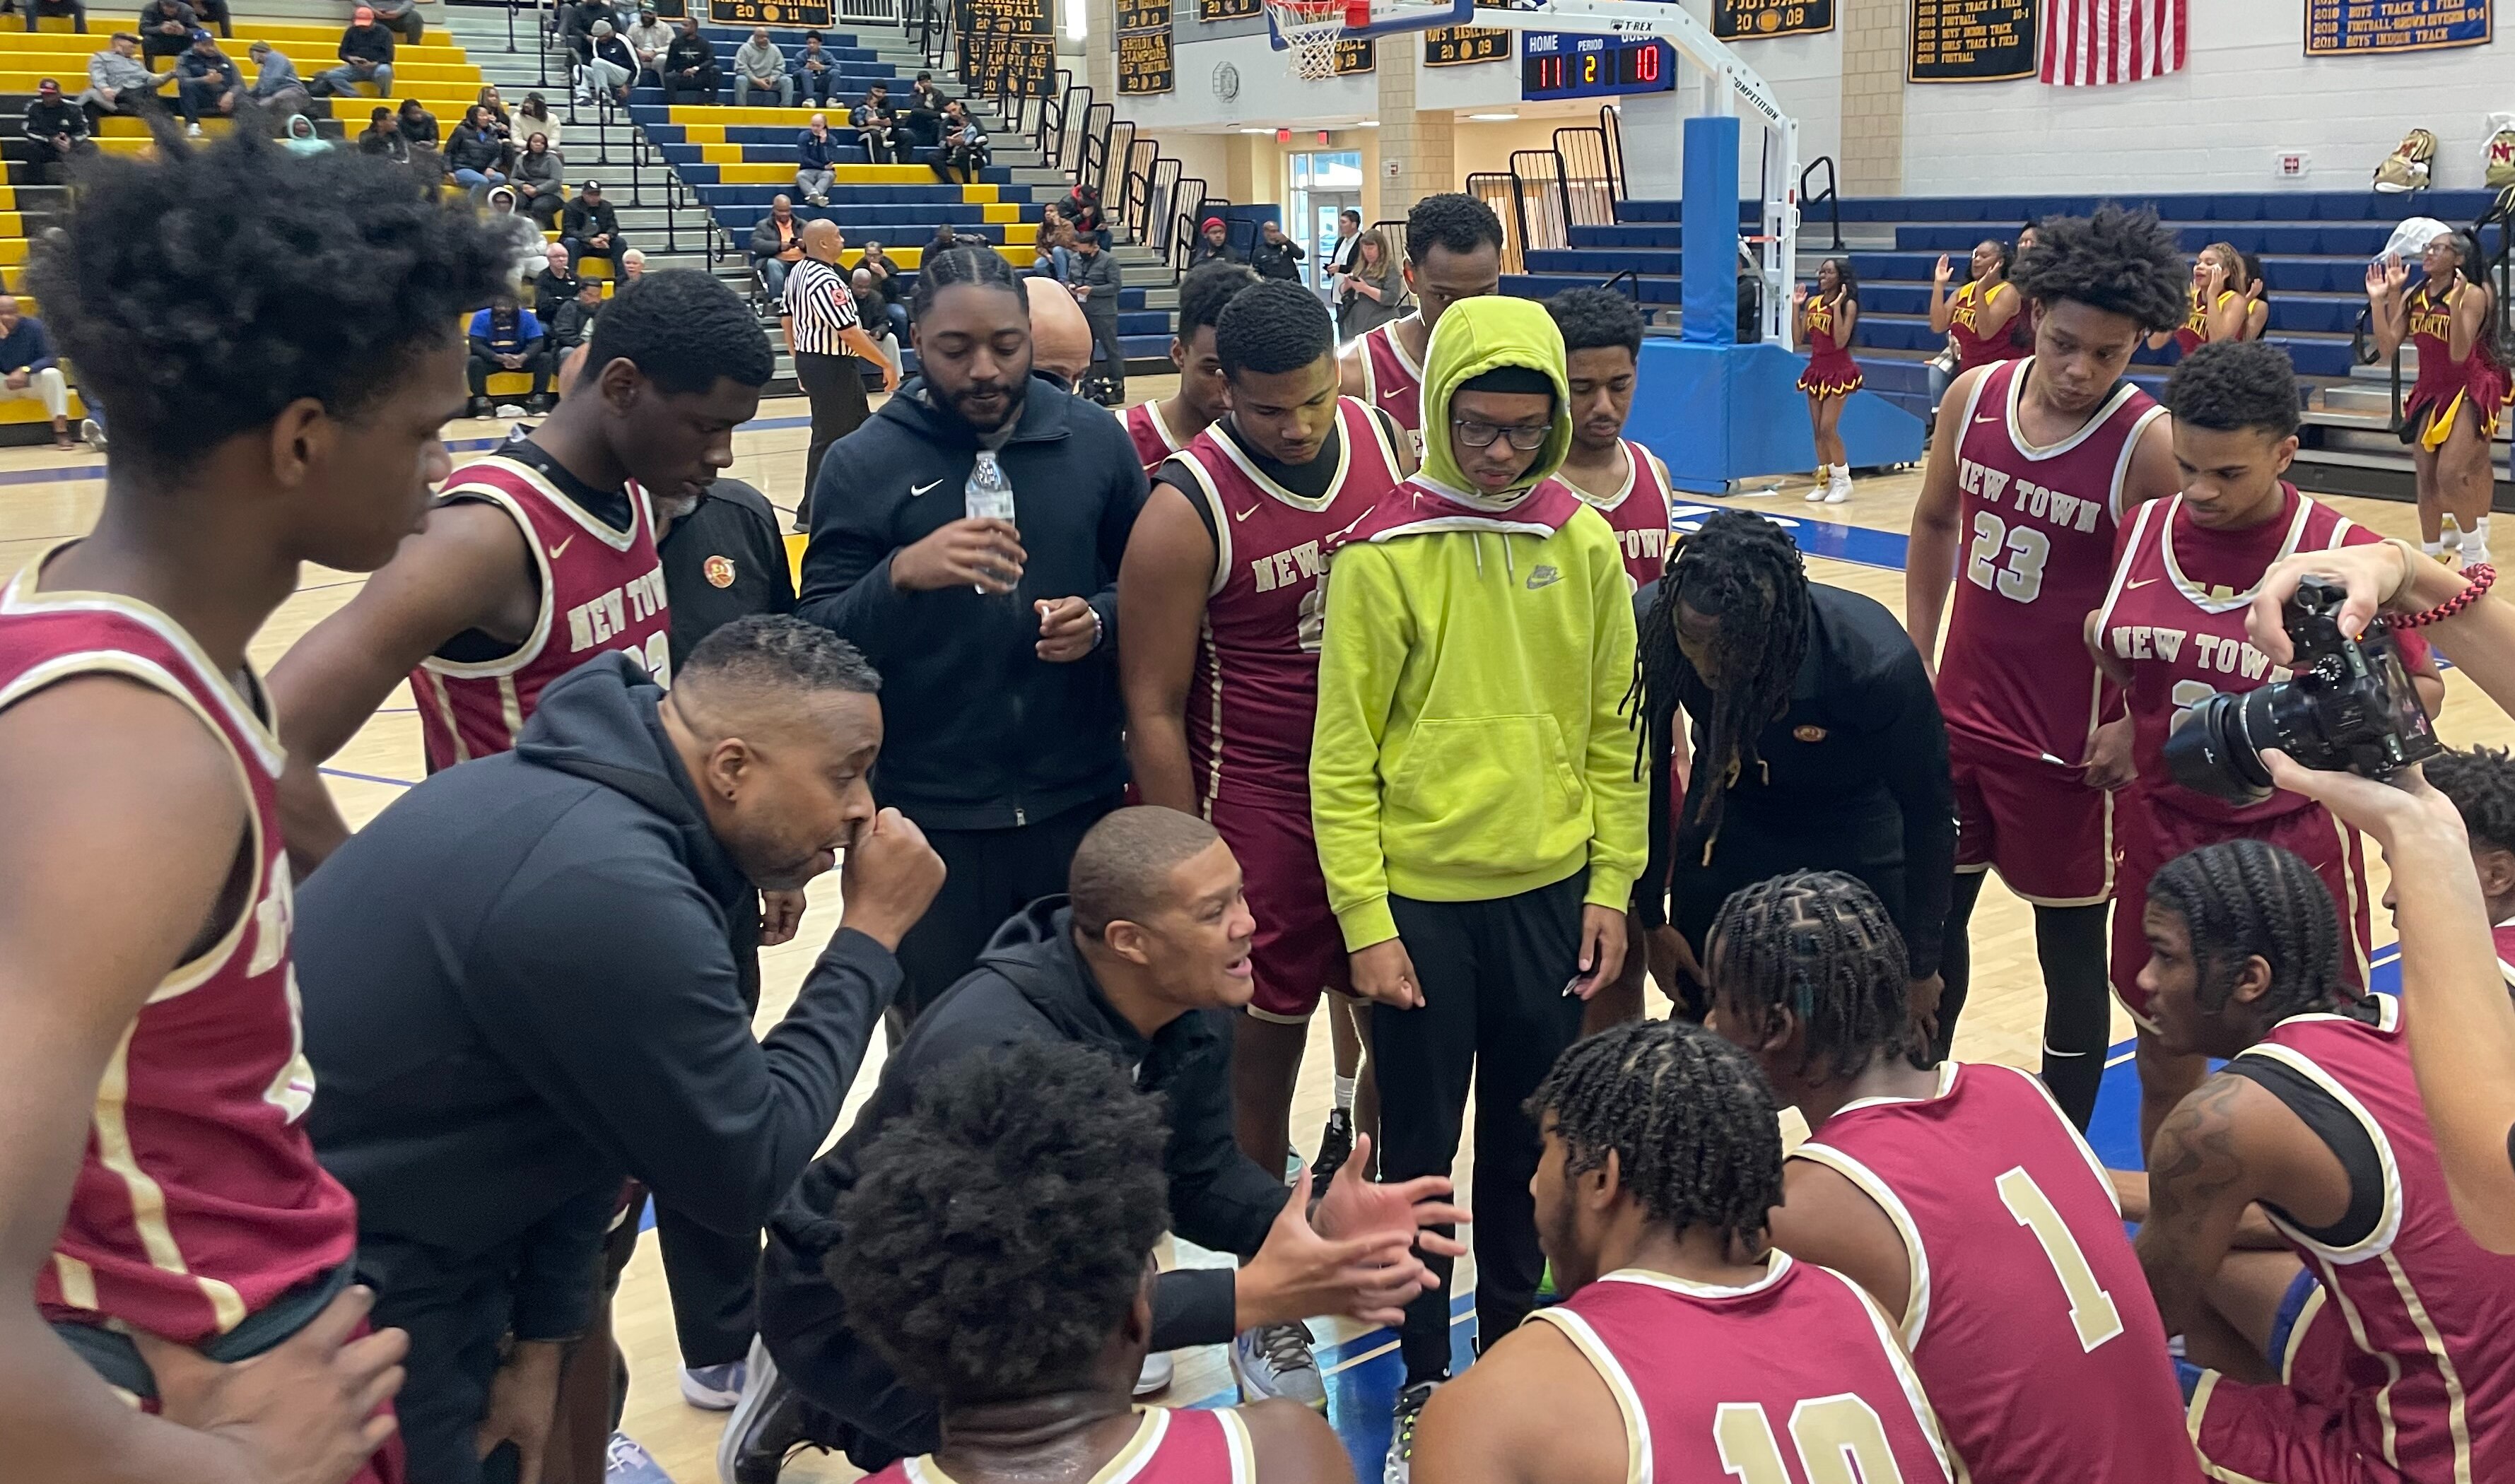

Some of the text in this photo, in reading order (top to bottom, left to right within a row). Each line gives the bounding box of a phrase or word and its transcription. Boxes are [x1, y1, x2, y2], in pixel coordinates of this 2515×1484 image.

[736, 4, 799, 20] 20 11
[1207, 1, 1221, 13] 20
[2381, 1, 2415, 16] TRACK
[1019, 20, 1032, 32] 10
[1626, 20, 1653, 32] T-REX
[1736, 13, 1752, 31] 20
[1529, 35, 1559, 52] HOME
[1577, 38, 1604, 52] PERIOD
[2415, 28, 2448, 42] TRACK
[1441, 39, 1493, 59] 20 09
[1541, 57, 1561, 87] 11
[1585, 54, 1597, 83] 2
[1636, 45, 1658, 81] 10
[2014, 478, 2102, 534] TOWN
[1251, 539, 1320, 594] NEW
[1967, 510, 2051, 604] 23
[568, 587, 626, 653] NEW
[2112, 625, 2187, 664] NEW
[1994, 1165, 2124, 1353] 1
